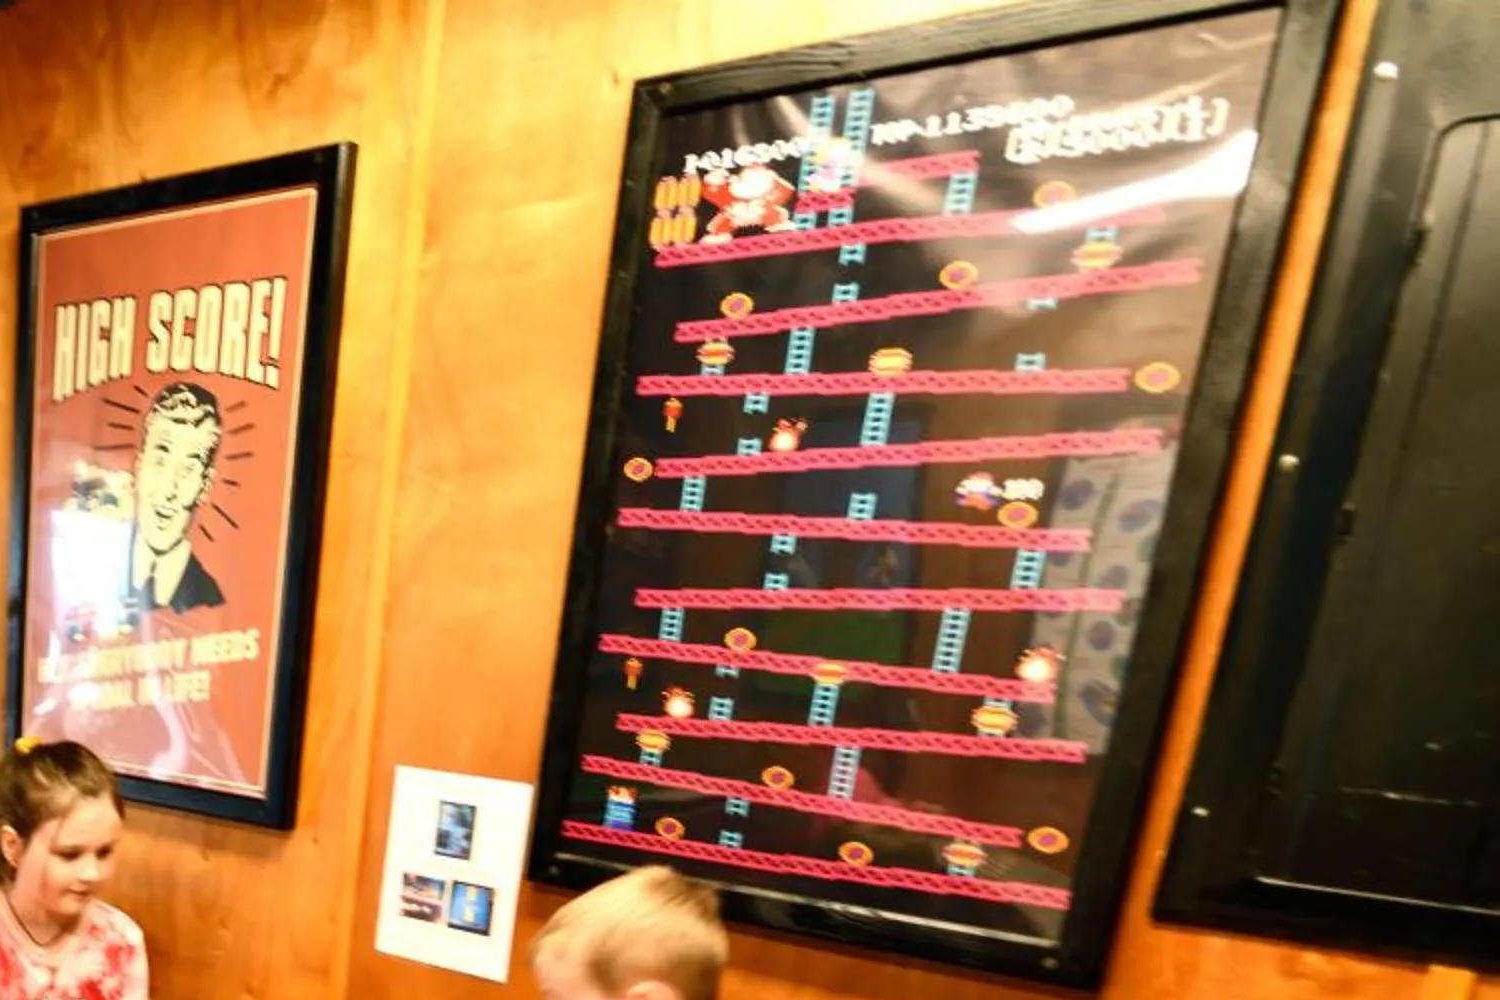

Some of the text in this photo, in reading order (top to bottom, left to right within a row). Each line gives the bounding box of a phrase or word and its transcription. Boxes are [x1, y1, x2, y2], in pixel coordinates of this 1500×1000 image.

[52, 274, 289, 404] HIGH SCORE!
[190, 627, 261, 666] NEEDS
